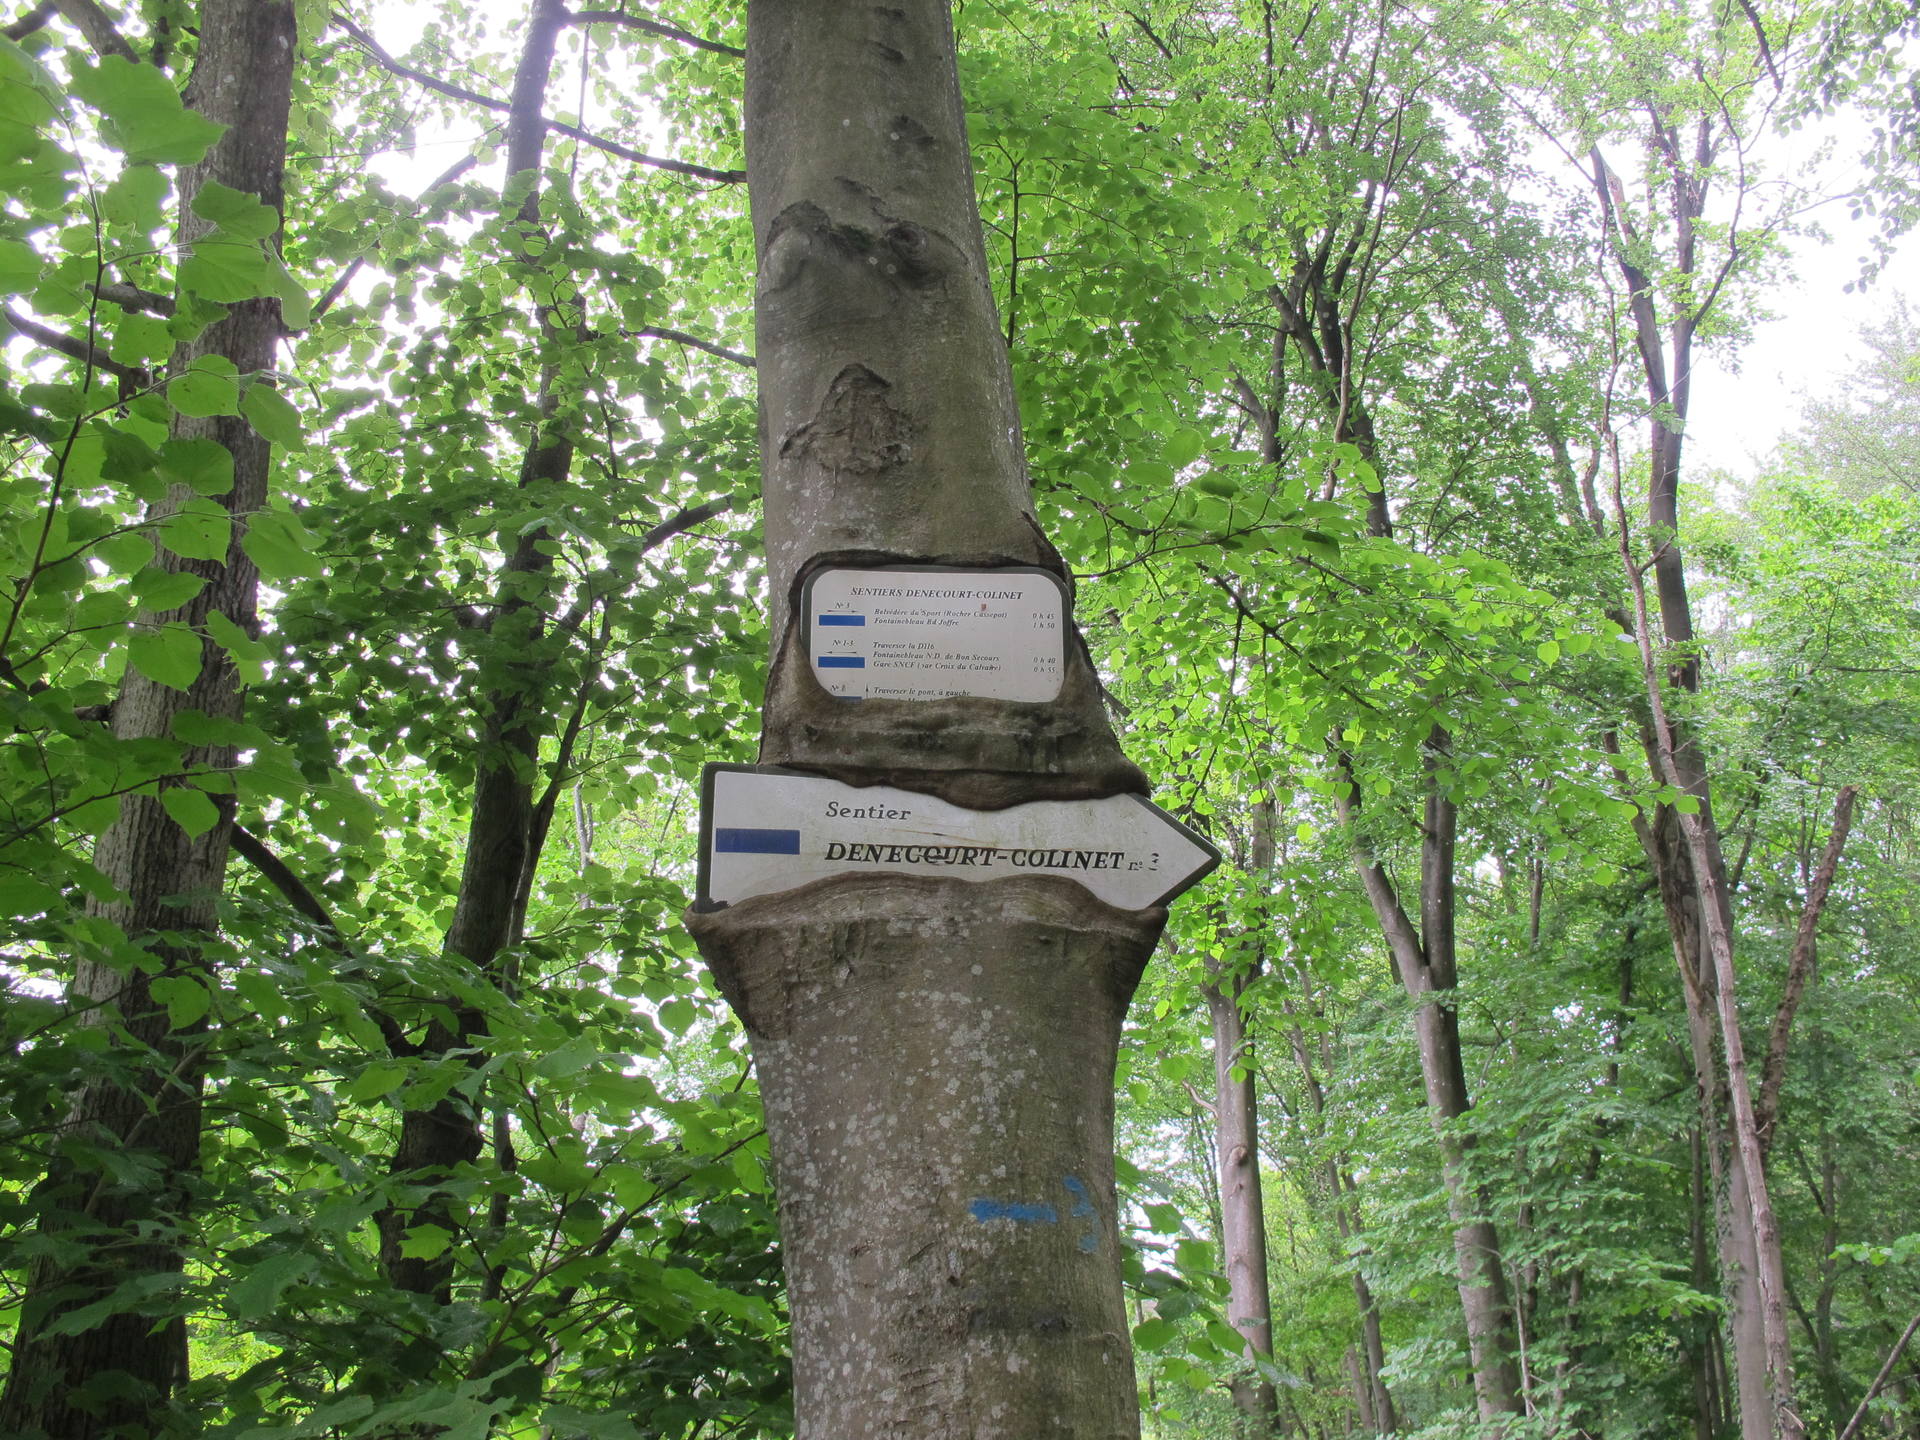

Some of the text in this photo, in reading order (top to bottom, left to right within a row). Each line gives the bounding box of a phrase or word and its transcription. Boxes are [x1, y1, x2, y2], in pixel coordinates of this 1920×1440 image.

[850, 587, 1023, 600] SENTIERS DENECOURT-COLINET
[938, 619, 959, 627] Joffre
[872, 641, 906, 649] Traverser
[908, 641, 916, 649] la
[872, 651, 924, 659] Fontainebleau
[944, 653, 953, 661] de
[971, 654, 1000, 662] Secours
[873, 660, 891, 668] Gare
[892, 661, 915, 669] SNCF
[935, 662, 955, 670] Croix
[873, 686, 907, 695] Traverser
[908, 687, 916, 695] le
[917, 688, 936, 697] pont,
[945, 688, 971, 697] gauche
[825, 801, 911, 820] Sentier
[824, 842, 1125, 872] DENECOURT-COLINET
